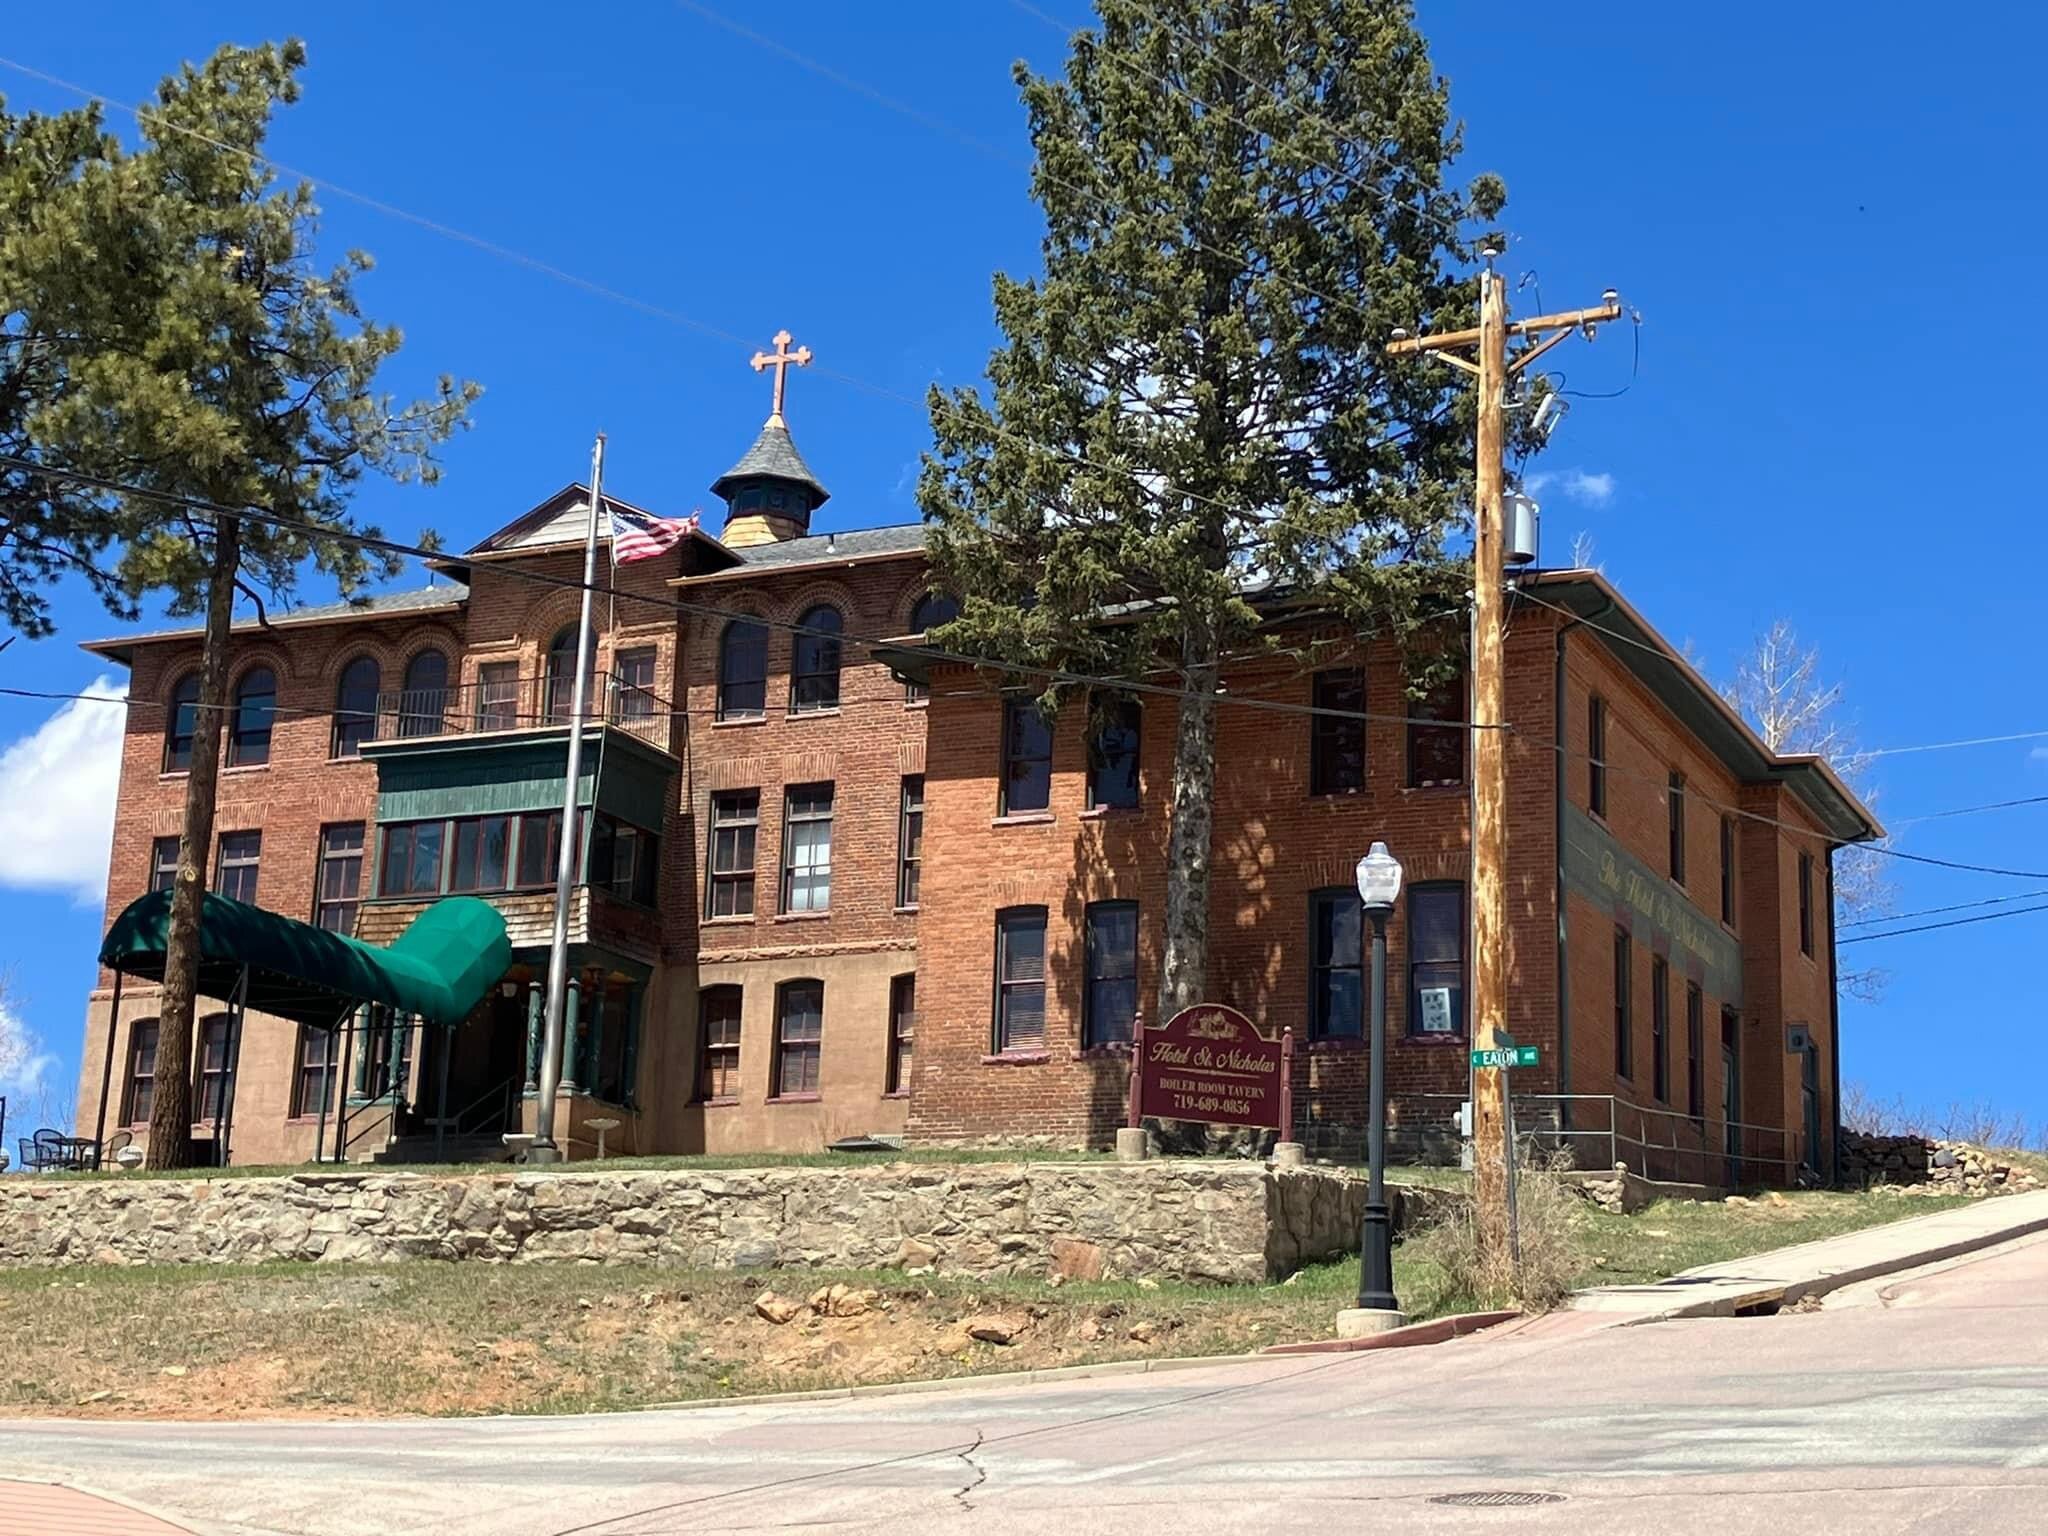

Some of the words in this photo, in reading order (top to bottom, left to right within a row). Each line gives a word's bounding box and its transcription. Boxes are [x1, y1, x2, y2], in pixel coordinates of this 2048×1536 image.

[1149, 1042, 1192, 1064] Hotel
[1193, 1046, 1213, 1067] St.
[1216, 1048, 1275, 1072] Nicholas
[1482, 1050, 1518, 1066] EATON
[1160, 1077, 1196, 1091] BOILER
[1198, 1081, 1226, 1095] ROOM
[1227, 1085, 1265, 1098] TAVERN
[1174, 1093, 1250, 1114] 719-689-0856
